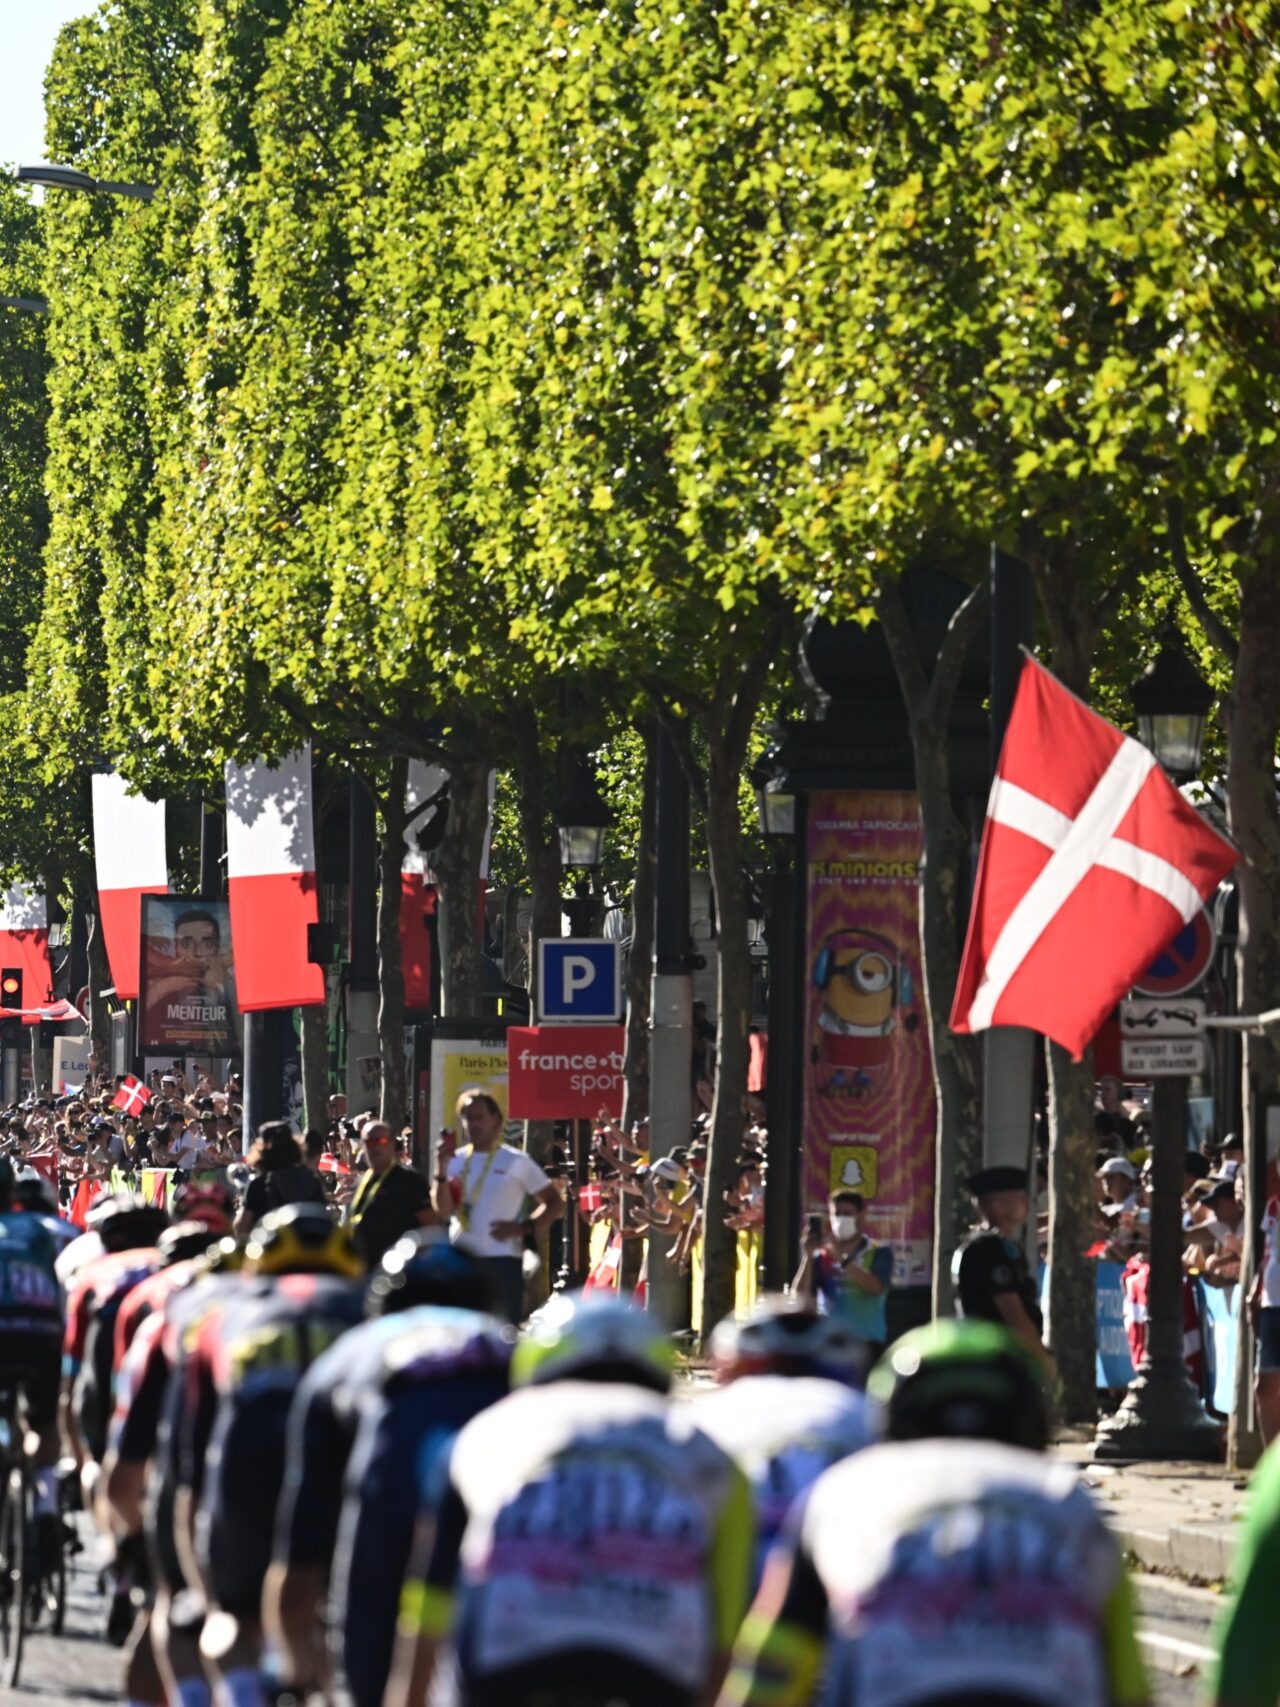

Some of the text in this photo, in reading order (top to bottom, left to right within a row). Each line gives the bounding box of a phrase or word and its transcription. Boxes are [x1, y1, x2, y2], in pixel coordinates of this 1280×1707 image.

[562, 955, 596, 1004] P
[167, 1004, 226, 1022] MENTEUR
[460, 1056, 488, 1068] Paris
